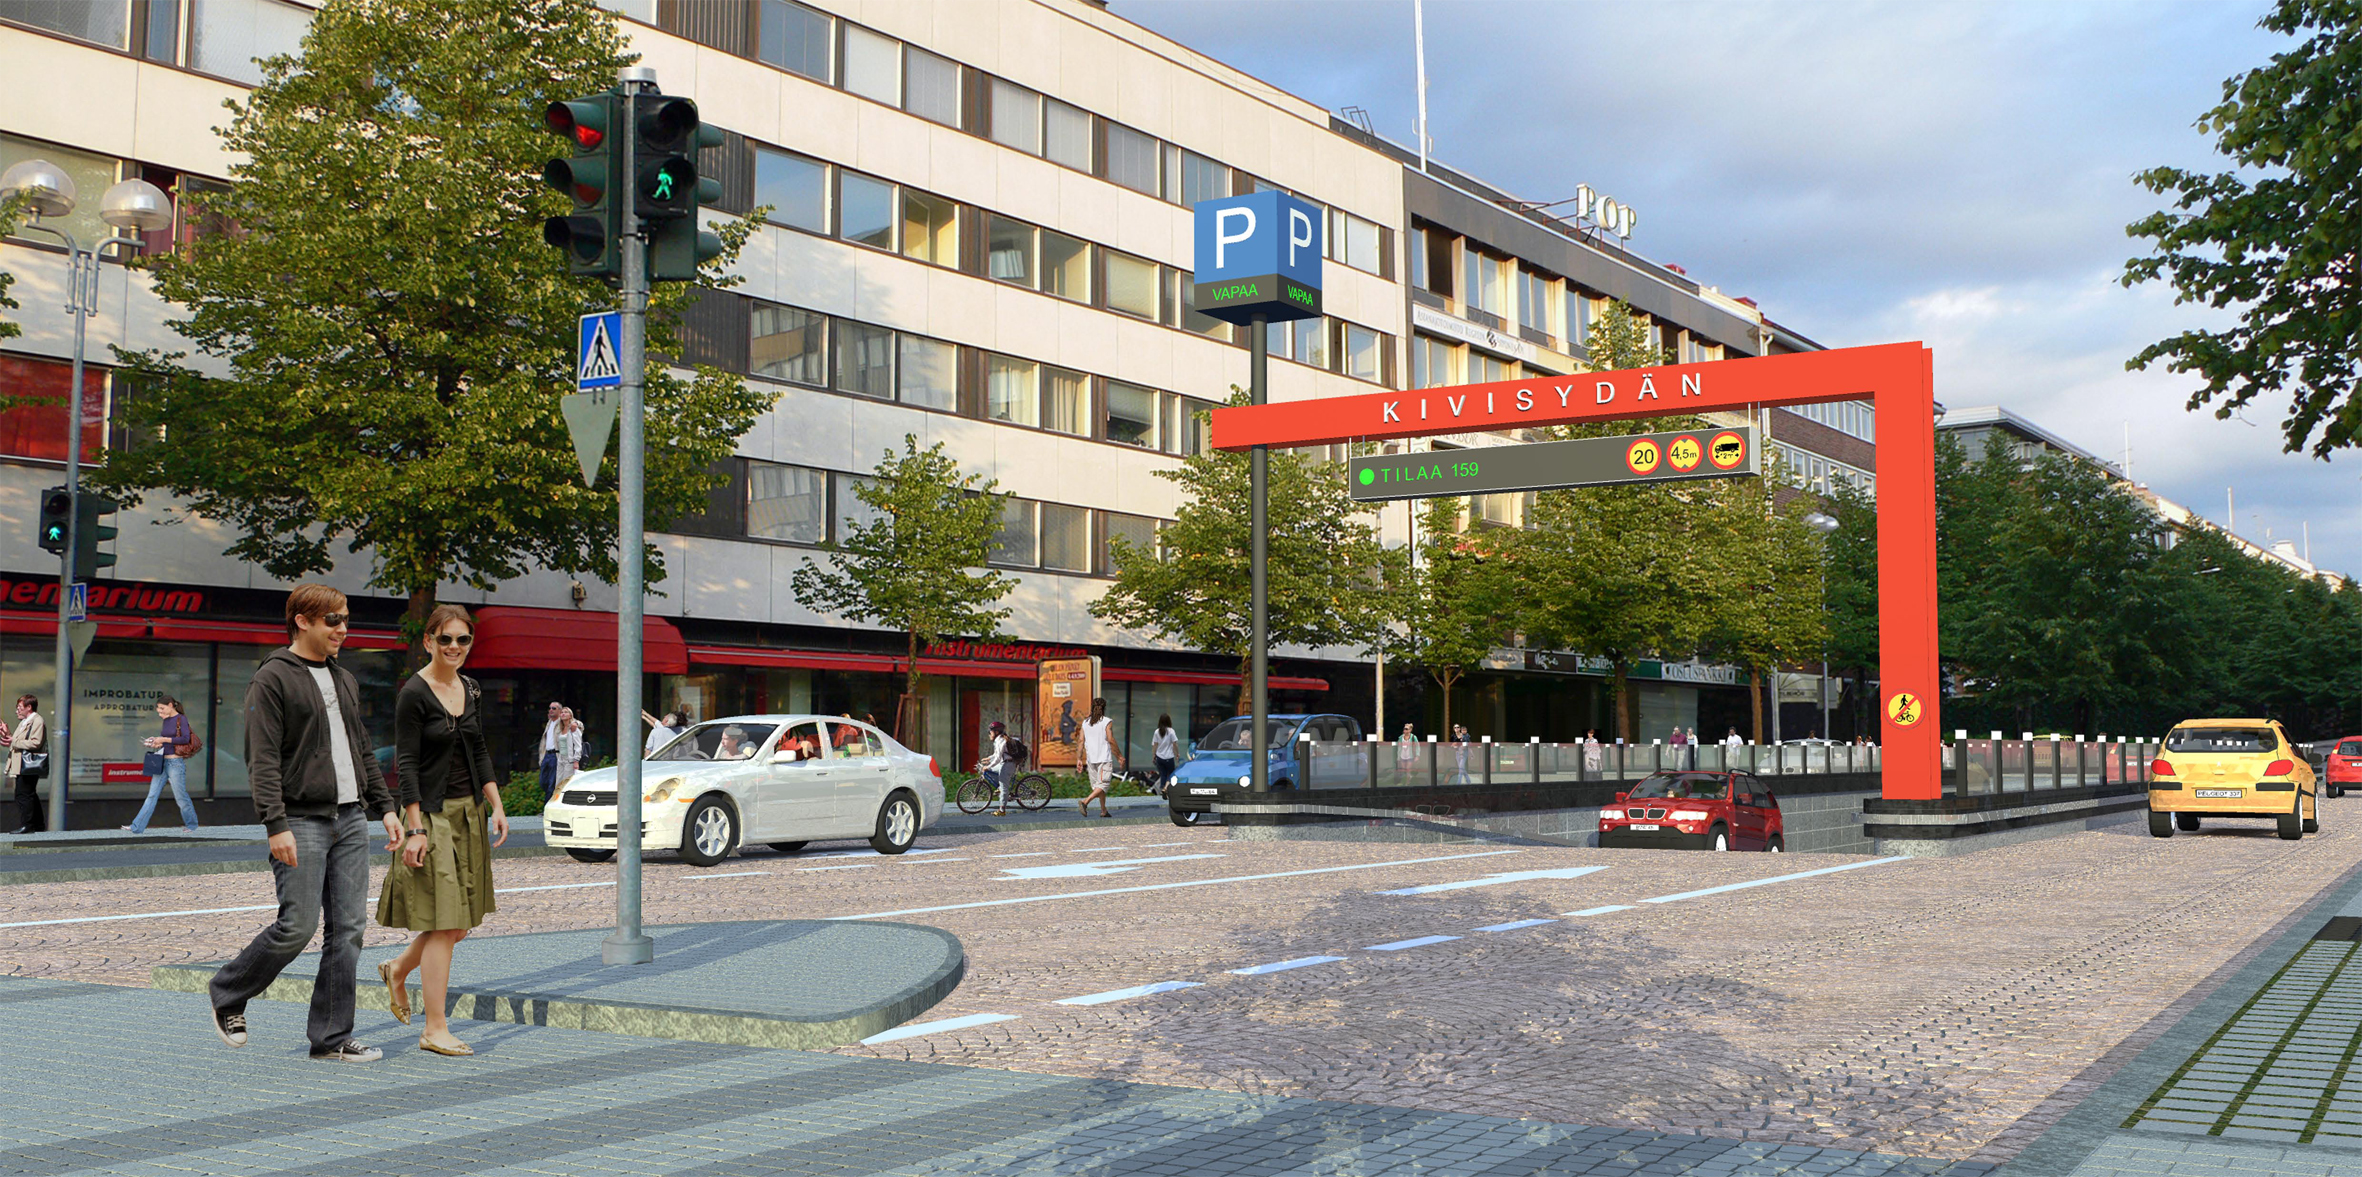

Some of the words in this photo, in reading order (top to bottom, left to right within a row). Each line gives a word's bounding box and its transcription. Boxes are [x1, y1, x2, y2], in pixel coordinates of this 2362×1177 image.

[1576, 184, 1637, 239] POP
[1216, 206, 1256, 269] P
[1289, 207, 1312, 267] P
[1212, 283, 1259, 301] VAPAA
[1287, 284, 1314, 307] VAPAA
[1382, 372, 1702, 424] KIVISYDÄN
[1634, 449, 1654, 465] 20
[1671, 446, 1697, 460] 4,5m
[1380, 465, 1443, 483] TILAA
[1451, 461, 1479, 478] 159
